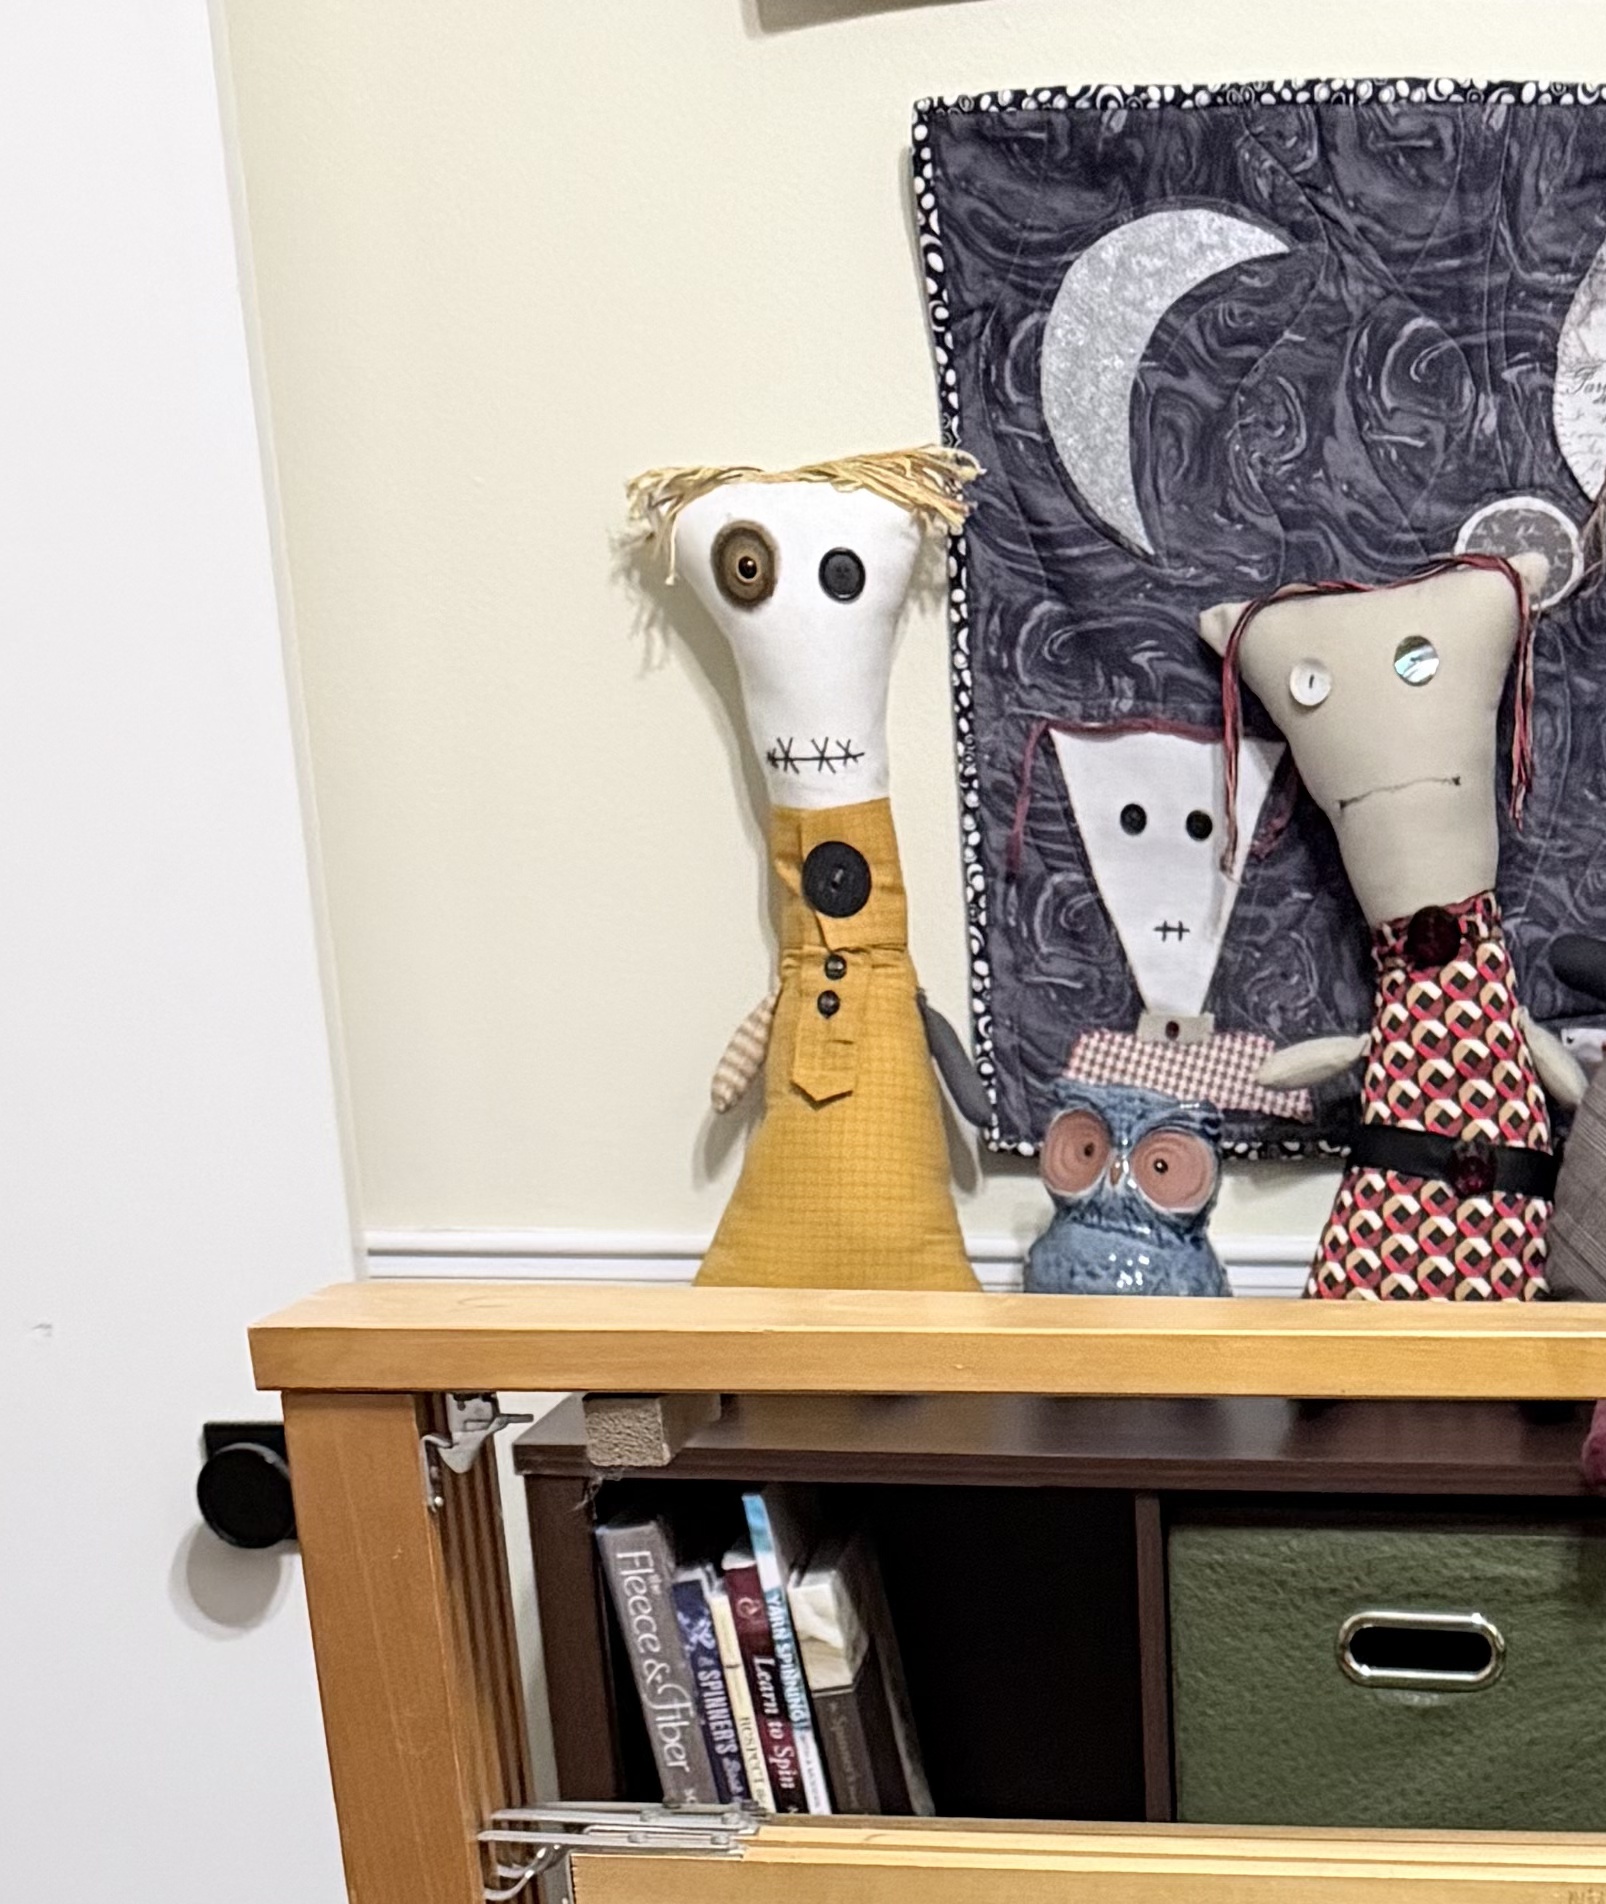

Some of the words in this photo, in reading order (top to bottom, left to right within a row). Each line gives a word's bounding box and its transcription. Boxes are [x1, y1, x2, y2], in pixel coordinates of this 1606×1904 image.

[616, 1550, 661, 1654] Fleece
[766, 1594, 793, 1641] YARN
[643, 1658, 670, 1684] &
[753, 1655, 780, 1714] Learn
[775, 1641, 807, 1722] SPINNING
[643, 1683, 695, 1773] Fiber
[697, 1670, 738, 1755] SPINNER'S
[766, 1718, 784, 1740] to
[769, 1745, 796, 1789] Spin
